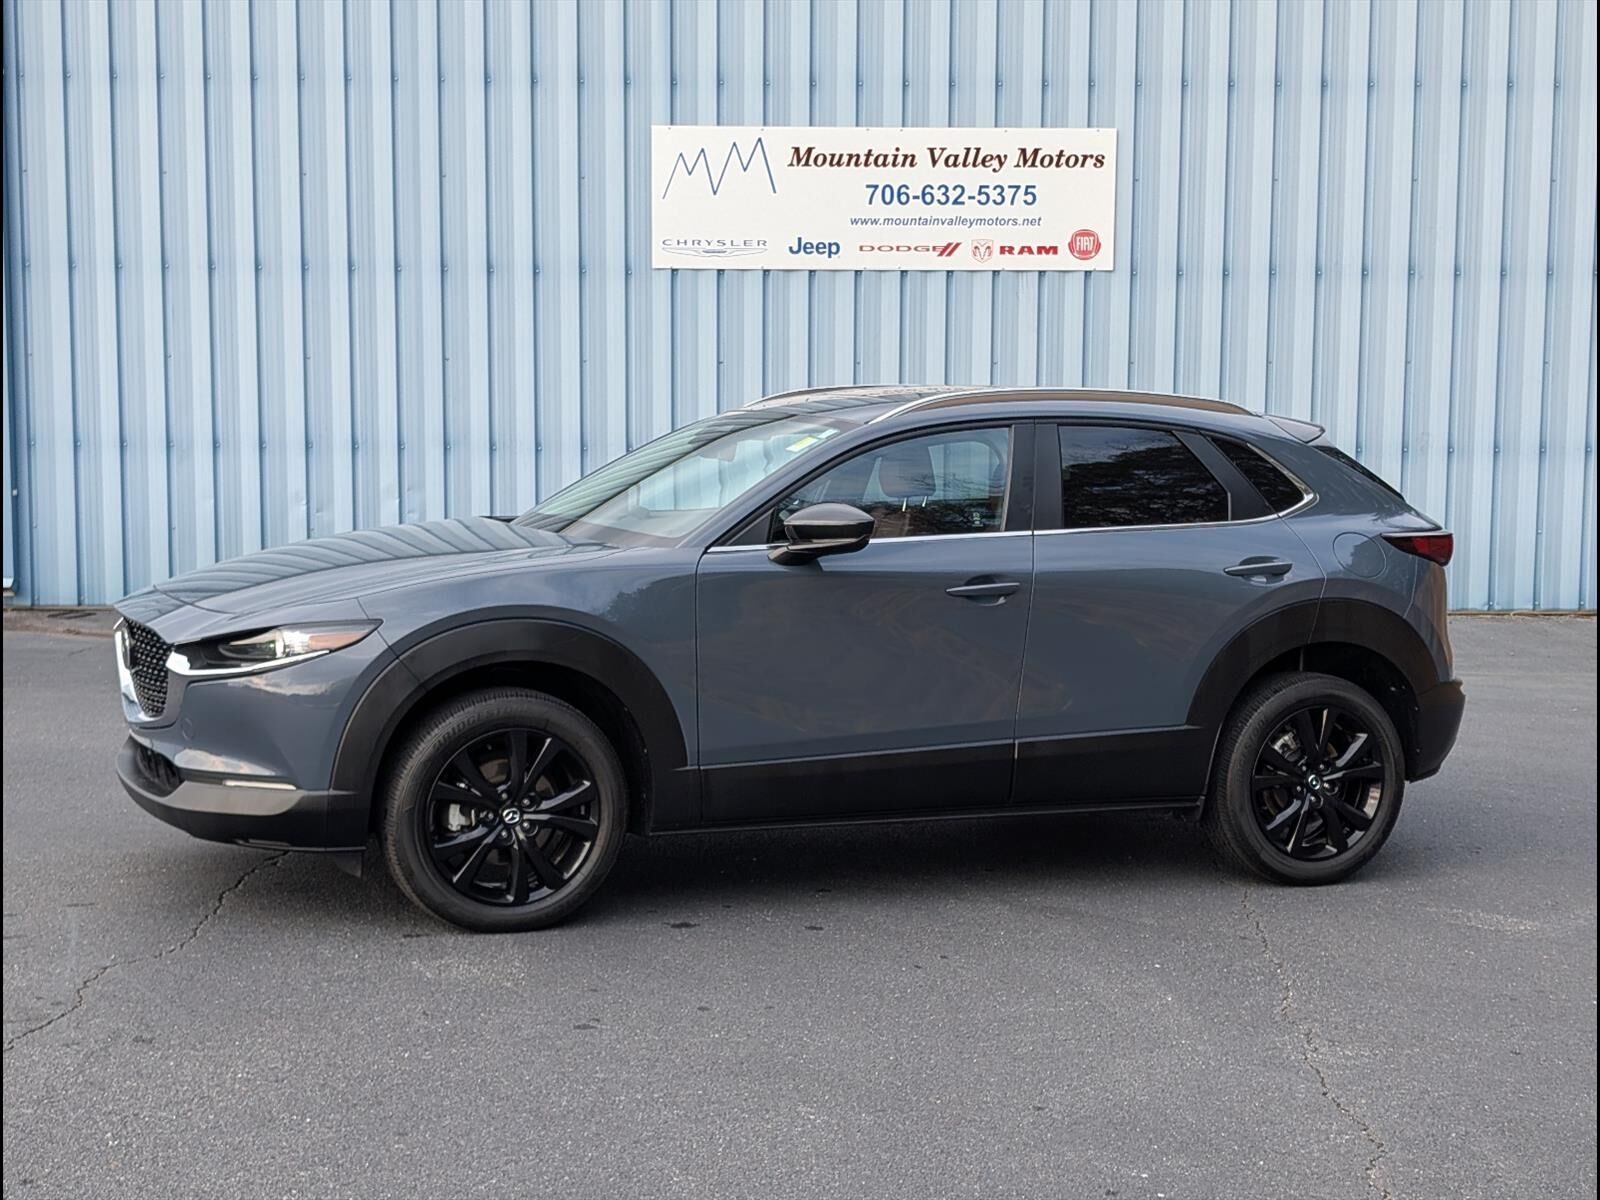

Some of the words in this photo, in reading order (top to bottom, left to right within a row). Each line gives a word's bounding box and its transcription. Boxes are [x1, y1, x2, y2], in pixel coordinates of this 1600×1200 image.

[787, 146, 917, 168] Mountain
[927, 147, 1008, 173] Valley
[1014, 147, 1105, 168] Motors
[865, 184, 1037, 206] 706-632-5375
[850, 215, 1042, 229] www.mountainvalleymotors.net
[662, 239, 768, 247] CHRYSLER
[788, 236, 841, 258] Jeep
[999, 245, 1059, 256] RAM
[1075, 236, 1095, 251] FIAT
